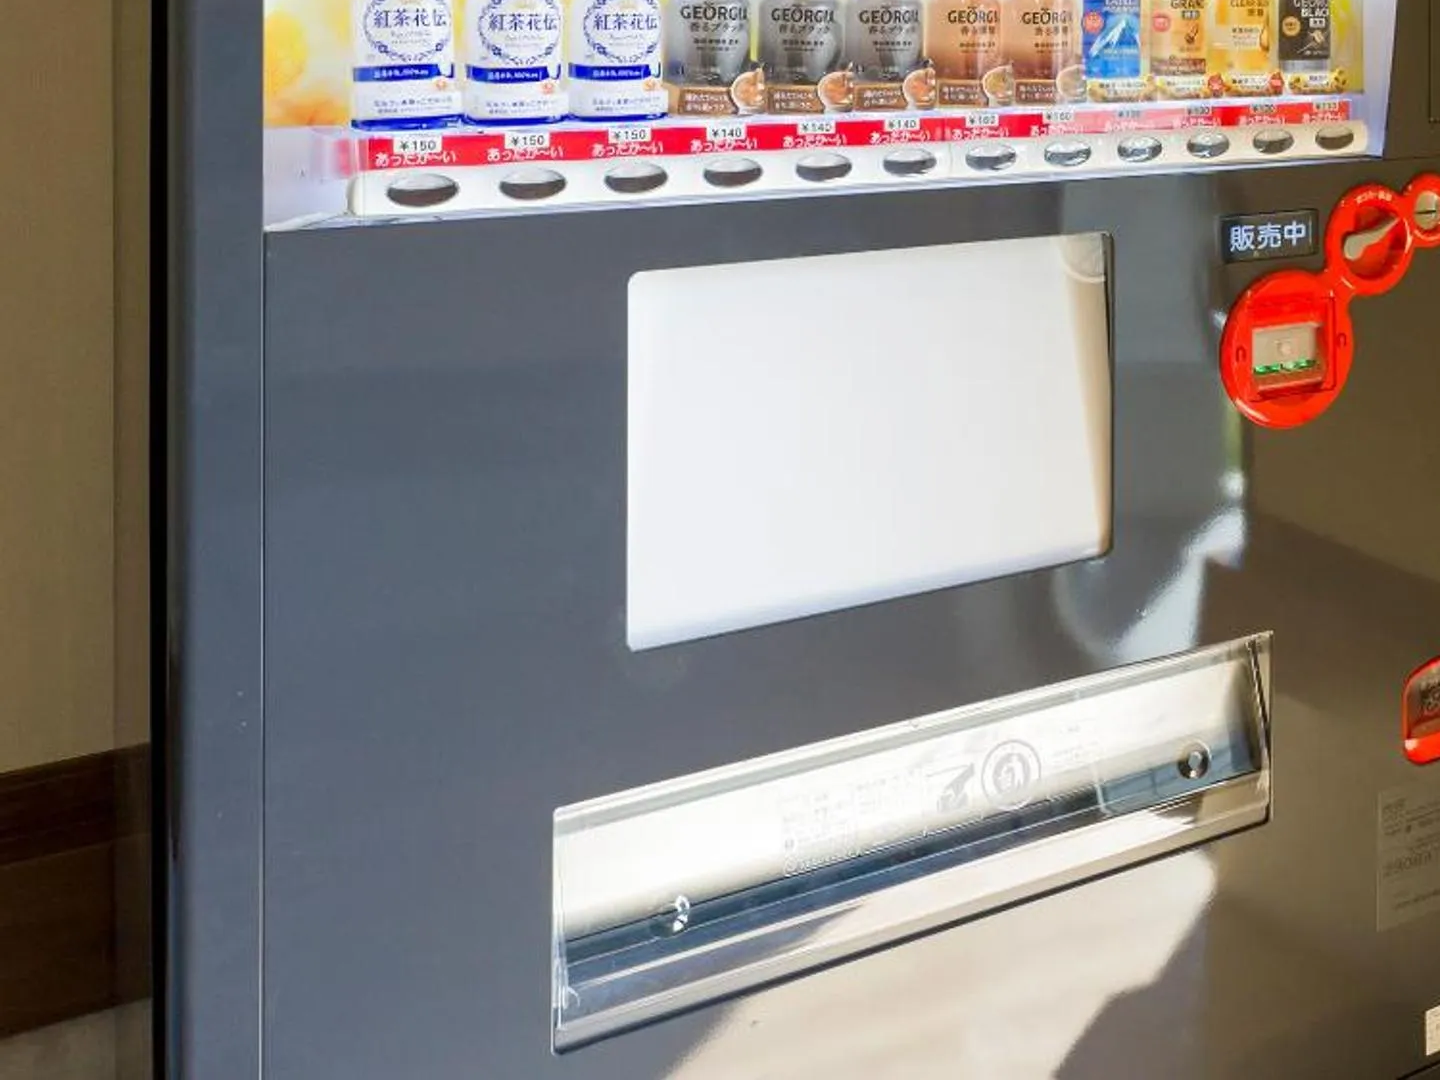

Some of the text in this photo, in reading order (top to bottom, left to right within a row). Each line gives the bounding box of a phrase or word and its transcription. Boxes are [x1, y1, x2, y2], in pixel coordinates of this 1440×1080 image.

[1171, 0, 1205, 9] GRAN
[1301, 8, 1329, 17] BLAC
[374, 9, 447, 28] 紅茶花伝
[488, 13, 558, 31] 紅茶花伝
[593, 13, 658, 30] 紅茶花伝
[948, 8, 999, 23] GEORGI
[1022, 9, 1072, 24] GEORGI
[511, 135, 545, 146] ¥150
[613, 129, 646, 140] ¥150
[711, 128, 742, 138] ¥140
[782, 133, 847, 149] あったか〜い
[400, 140, 436, 151] ¥150
[592, 141, 664, 158] あったか〜い
[690, 137, 758, 154] あったか〜い
[375, 150, 457, 167] あったか〜い
[487, 146, 564, 162] あったか〜い
[1229, 221, 1307, 252] 販売中
